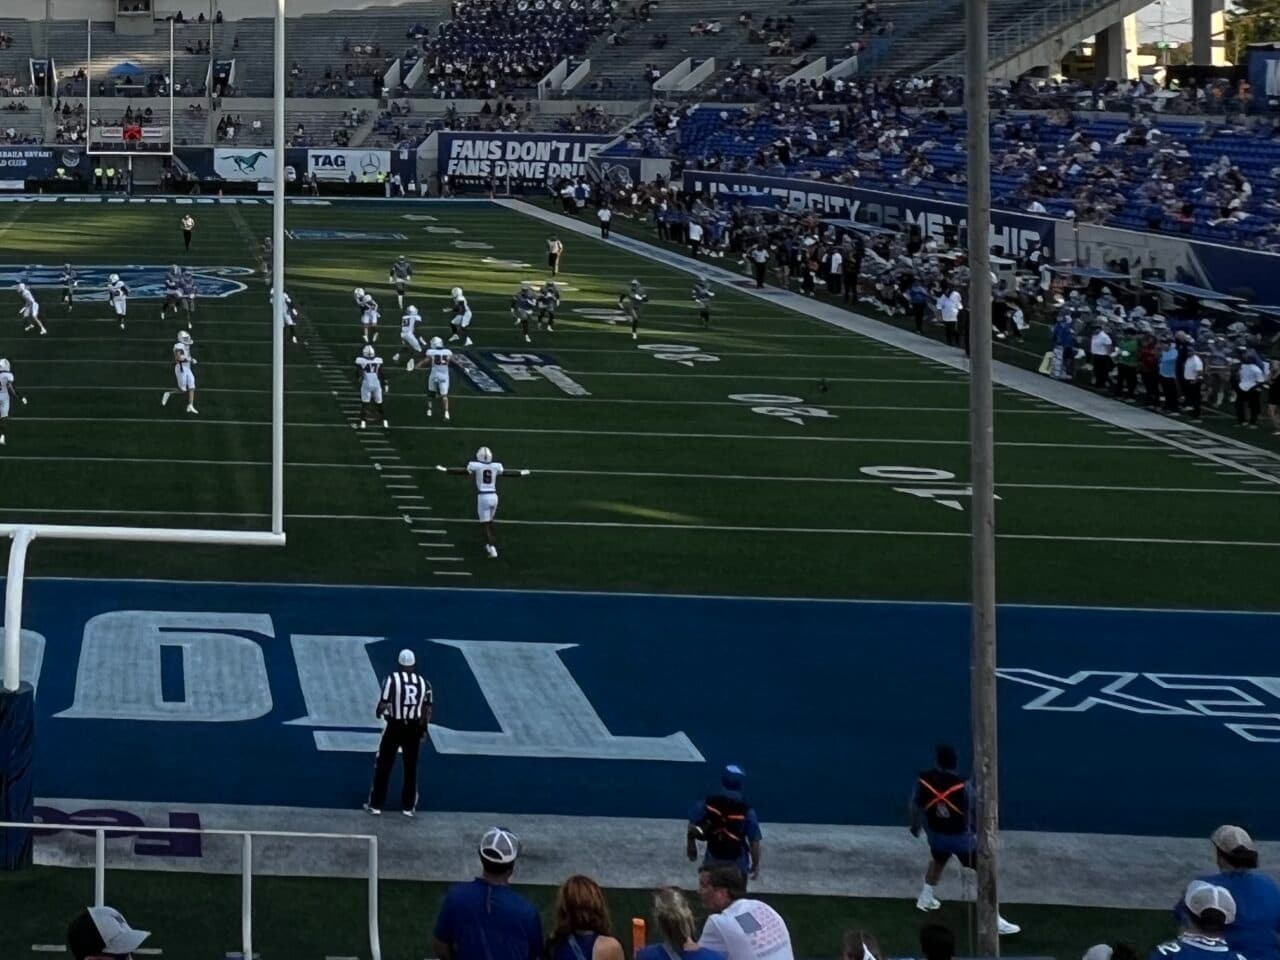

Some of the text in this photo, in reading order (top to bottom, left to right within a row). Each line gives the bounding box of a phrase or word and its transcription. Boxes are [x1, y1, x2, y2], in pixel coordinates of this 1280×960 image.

[450, 139, 502, 159] FANS
[505, 141, 569, 162] DON'T
[312, 154, 346, 167] TAG
[447, 160, 491, 177] FANS
[495, 161, 545, 178] DRIVE
[404, 684, 418, 705] R
